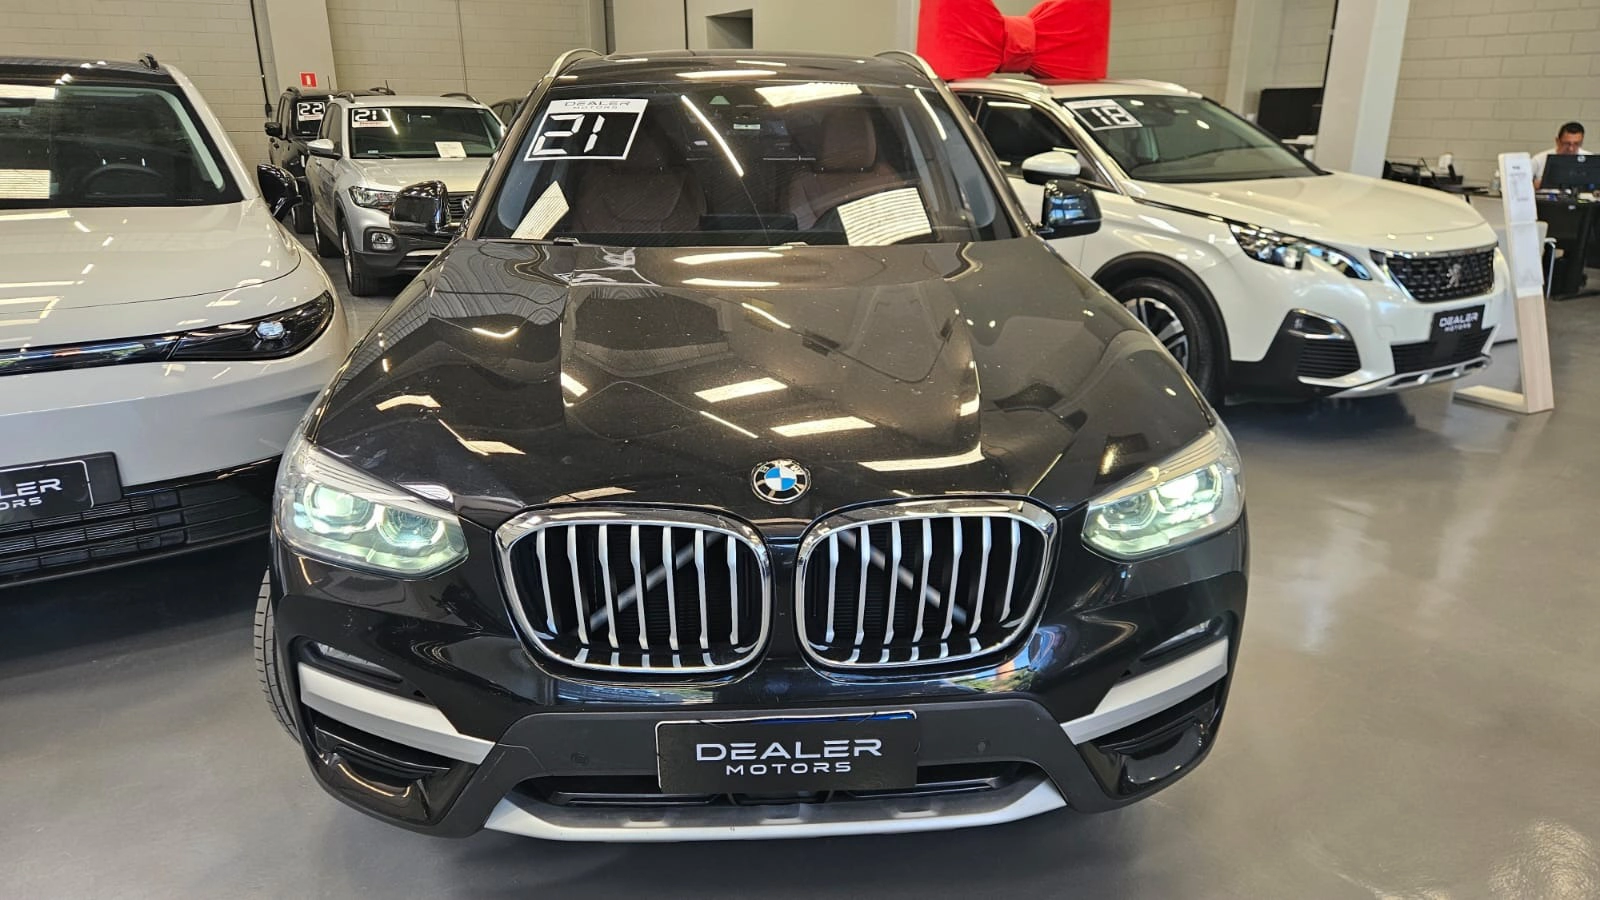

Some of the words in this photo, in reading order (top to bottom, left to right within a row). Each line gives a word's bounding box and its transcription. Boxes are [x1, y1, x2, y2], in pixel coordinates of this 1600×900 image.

[300, 102, 323, 115] 22
[354, 109, 378, 122] 21
[532, 113, 606, 156] 21
[1439, 312, 1479, 328] DEALER
[696, 738, 882, 761] DEALER
[726, 761, 852, 776] MOTORS
